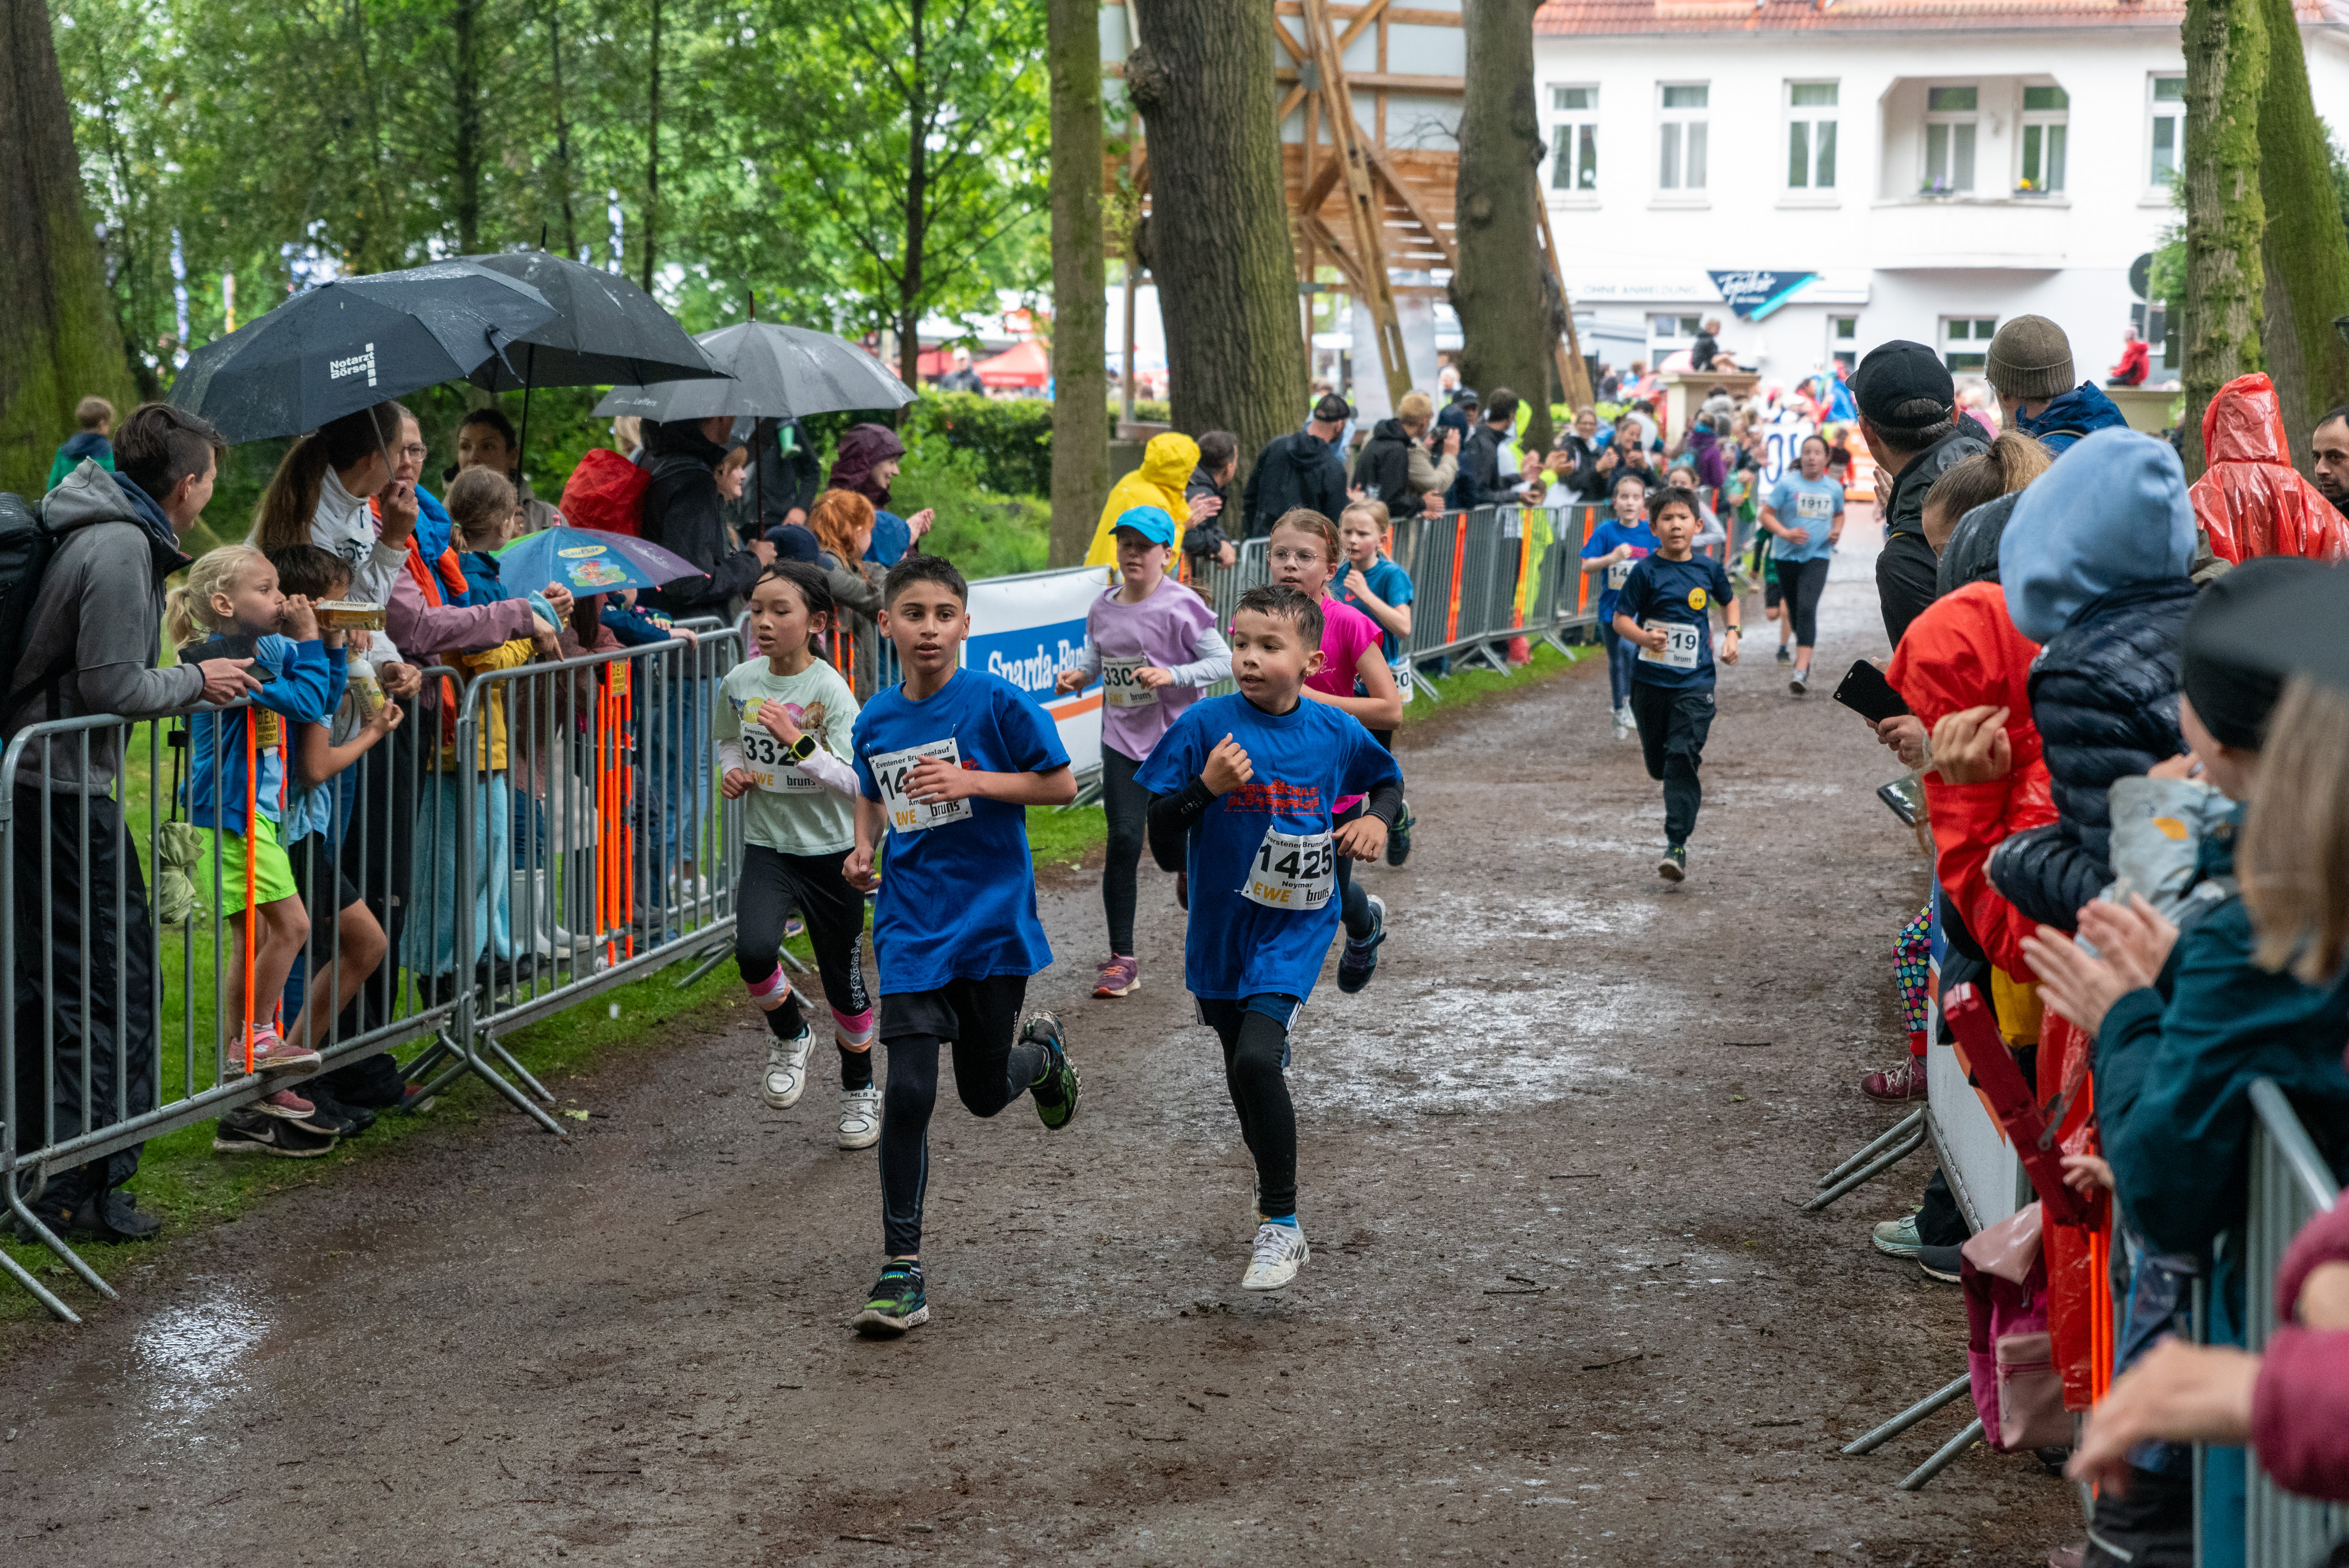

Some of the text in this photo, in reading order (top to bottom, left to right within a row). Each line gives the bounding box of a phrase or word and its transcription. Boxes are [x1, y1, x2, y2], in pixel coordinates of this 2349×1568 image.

[330, 351, 374, 369] Notarzt
[331, 364, 367, 379] Börse
[988, 633, 1090, 692] Sparda-Ban
[1674, 655, 1692, 663] bruns
[1130, 692, 1152, 700] bruns
[908, 746, 950, 762] Brunenlauf
[787, 775, 816, 786] bruns
[930, 800, 960, 817] bruns
[895, 809, 917, 826] EWE
[1265, 832, 1301, 849] Everstener
[1259, 843, 1333, 880] 1425
[1253, 881, 1292, 902] EWE
[1282, 881, 1313, 889] Neymar
[1306, 887, 1329, 901] bruns
